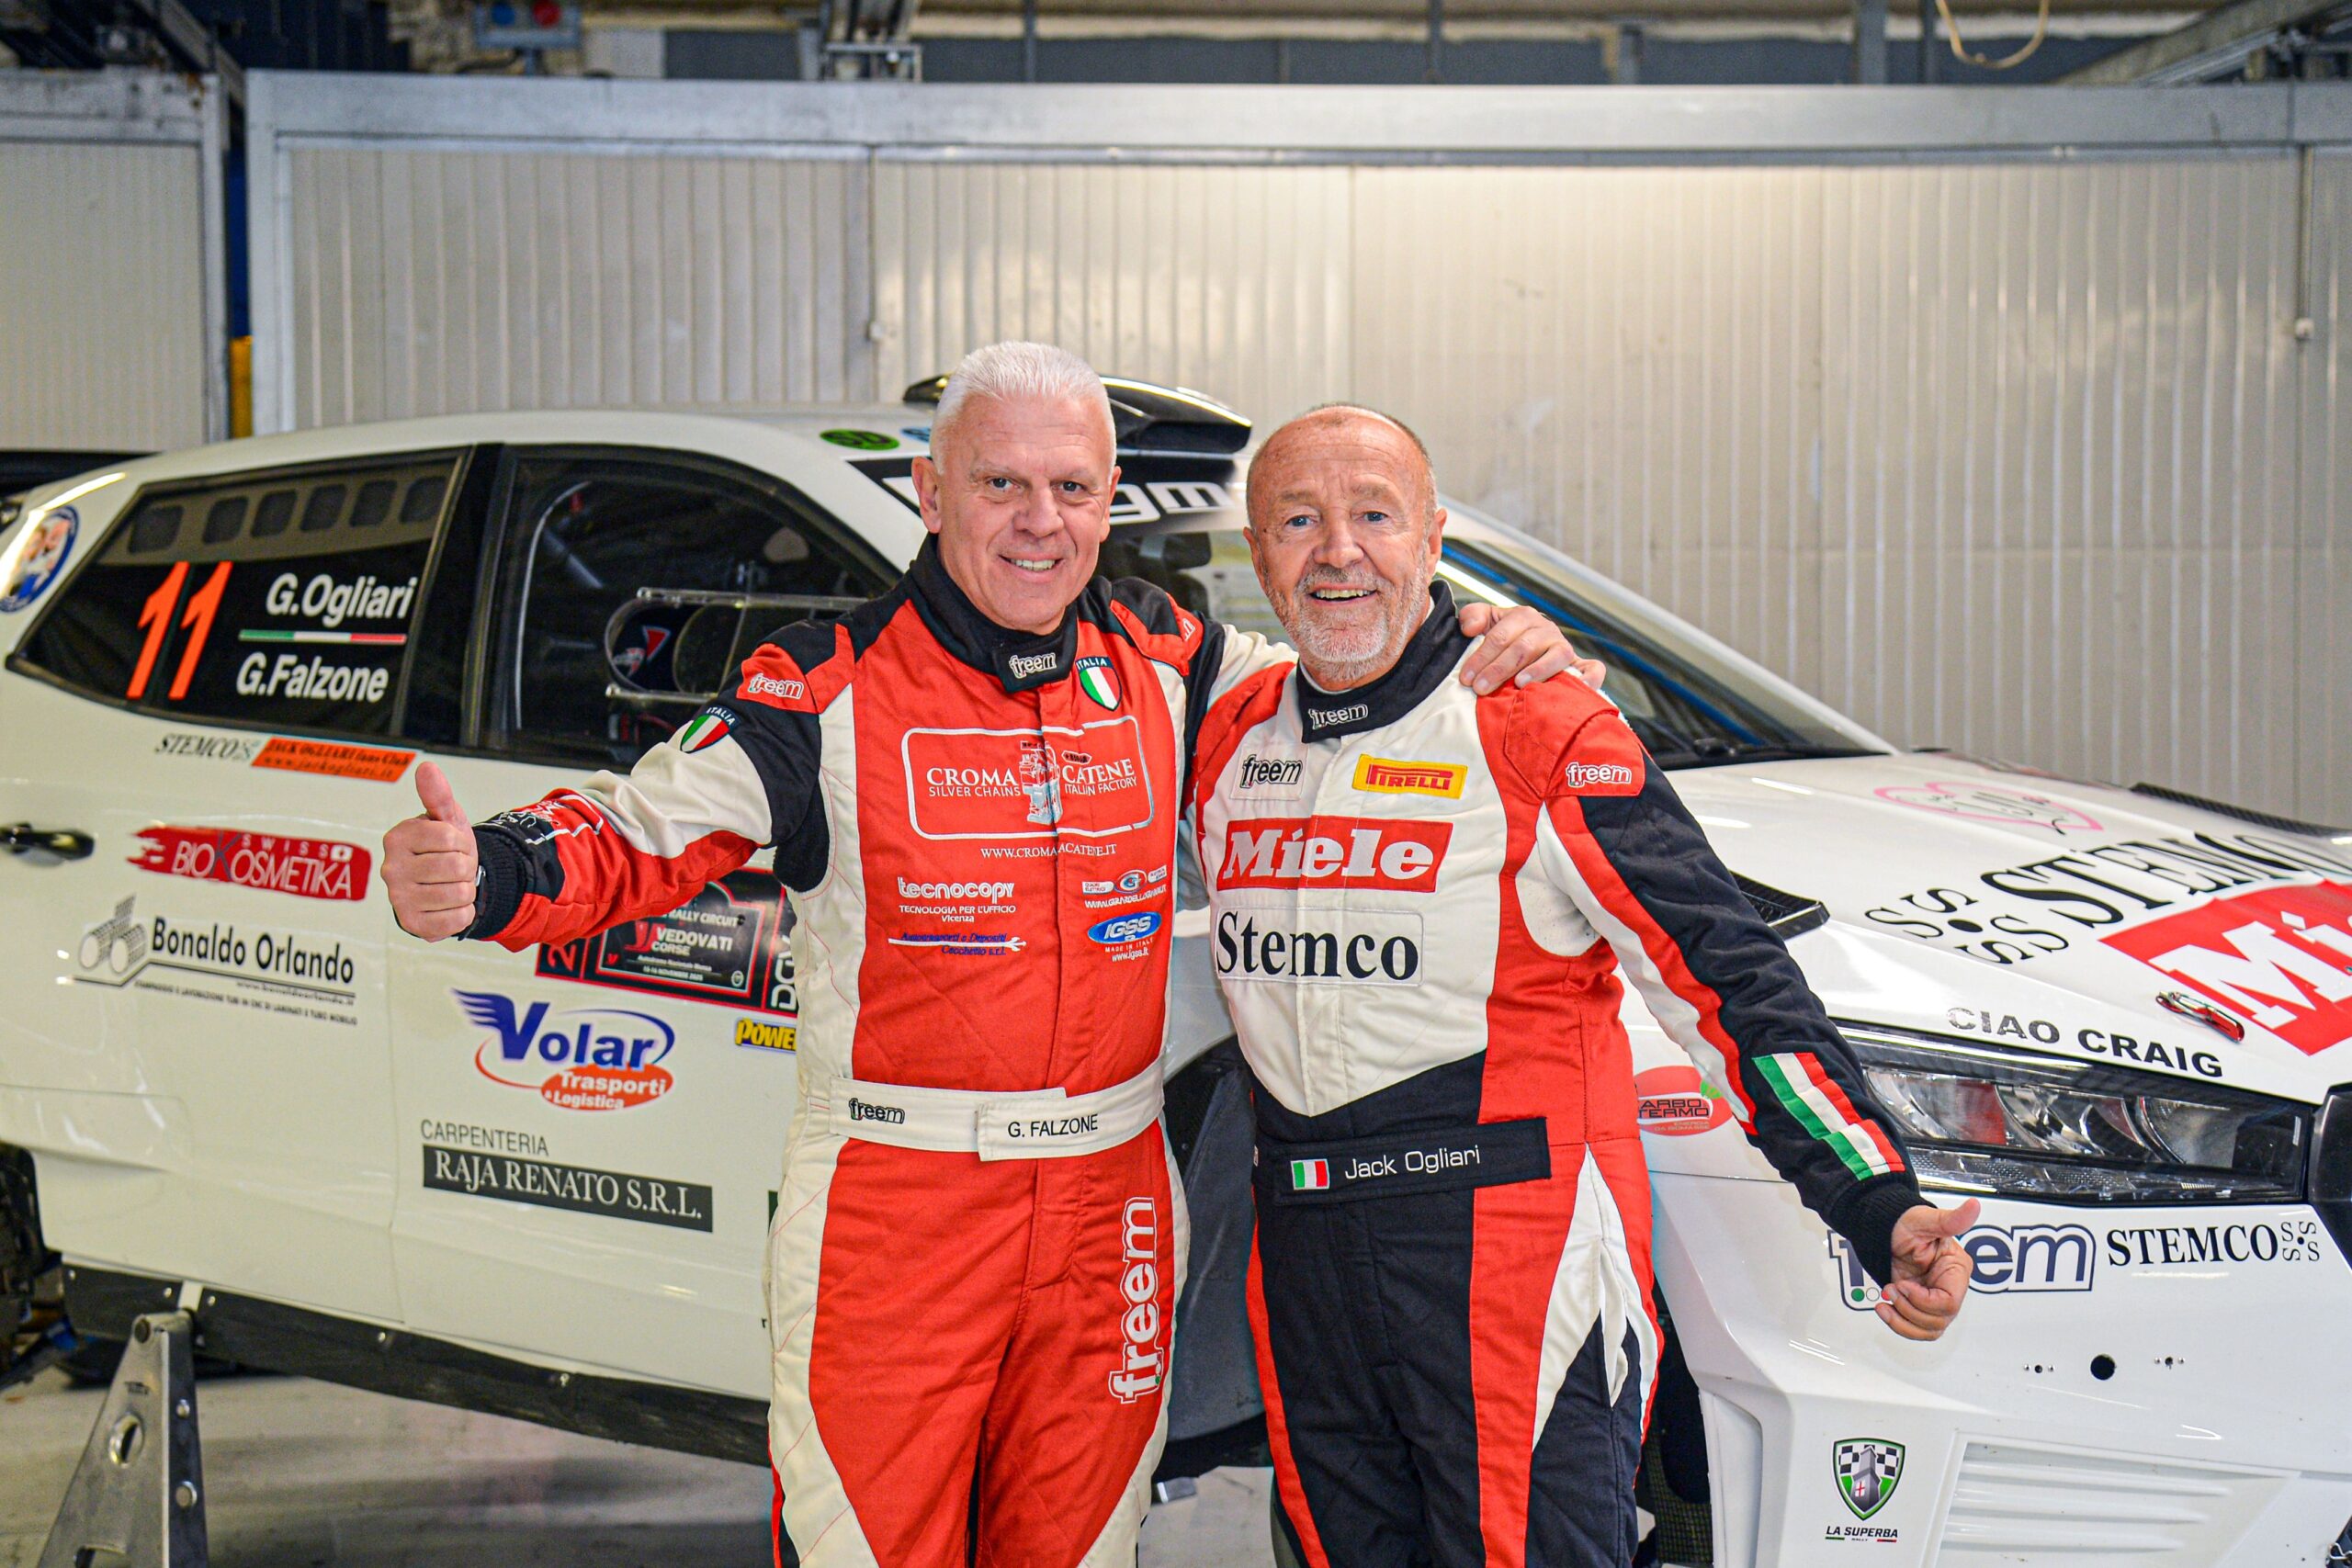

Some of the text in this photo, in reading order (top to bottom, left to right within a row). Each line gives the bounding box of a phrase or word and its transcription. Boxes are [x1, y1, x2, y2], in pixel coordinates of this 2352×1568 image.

[266, 572, 418, 627] G.Ogliari
[126, 561, 233, 700] 11
[236, 651, 390, 702] G.Falzone
[1009, 652, 1057, 679] freem
[1075, 657, 1108, 670] ITALIA
[747, 672, 805, 700] freem
[706, 705, 736, 726] ITALIA
[1307, 703, 1369, 730] freem
[155, 734, 237, 760] STEMCO
[925, 758, 1135, 787] CROMA CATENE
[1239, 753, 1303, 789] freem
[1366, 763, 1453, 791] PIRELLI
[1565, 761, 1633, 789] freem
[929, 776, 1137, 797] SILVER CHAINS ITALIN FACTORY
[242, 833, 329, 858] SWISS
[1223, 828, 1435, 880] Miele
[897, 876, 1015, 905] tecnocopy
[700, 913, 739, 928] CIRCUIT
[899, 904, 1016, 914] TECNOLOGIA PER L'UFFICIO
[942, 915, 975, 923] Vicenza
[656, 927, 734, 952] VEDOVATI
[1103, 915, 1152, 940] IGSS
[153, 915, 355, 984] Bonaldo Orlando
[650, 942, 691, 956] CORSE
[1216, 910, 1419, 981] Stemco
[449, 987, 655, 1069] Volar
[735, 1017, 797, 1052] POWE
[1947, 1007, 2223, 1079] CIAO CRAIG
[560, 1069, 667, 1097] Trasporti
[553, 1090, 625, 1110] Logistica
[848, 1097, 906, 1125] freem
[1639, 1107, 1710, 1119] TERMO
[1640, 1099, 1702, 1109] ARBO
[420, 1119, 549, 1157] CARPENTERIA
[1007, 1113, 1099, 1138] G. FALZONE
[1345, 1145, 1481, 1179] Jack Ogliari
[434, 1149, 703, 1220] RAJA RENATO S.R.L.
[2107, 1224, 2279, 1268] STEMCO
[1108, 1196, 1164, 1404] freem
[1826, 1525, 1898, 1539] LA SUPERBA
